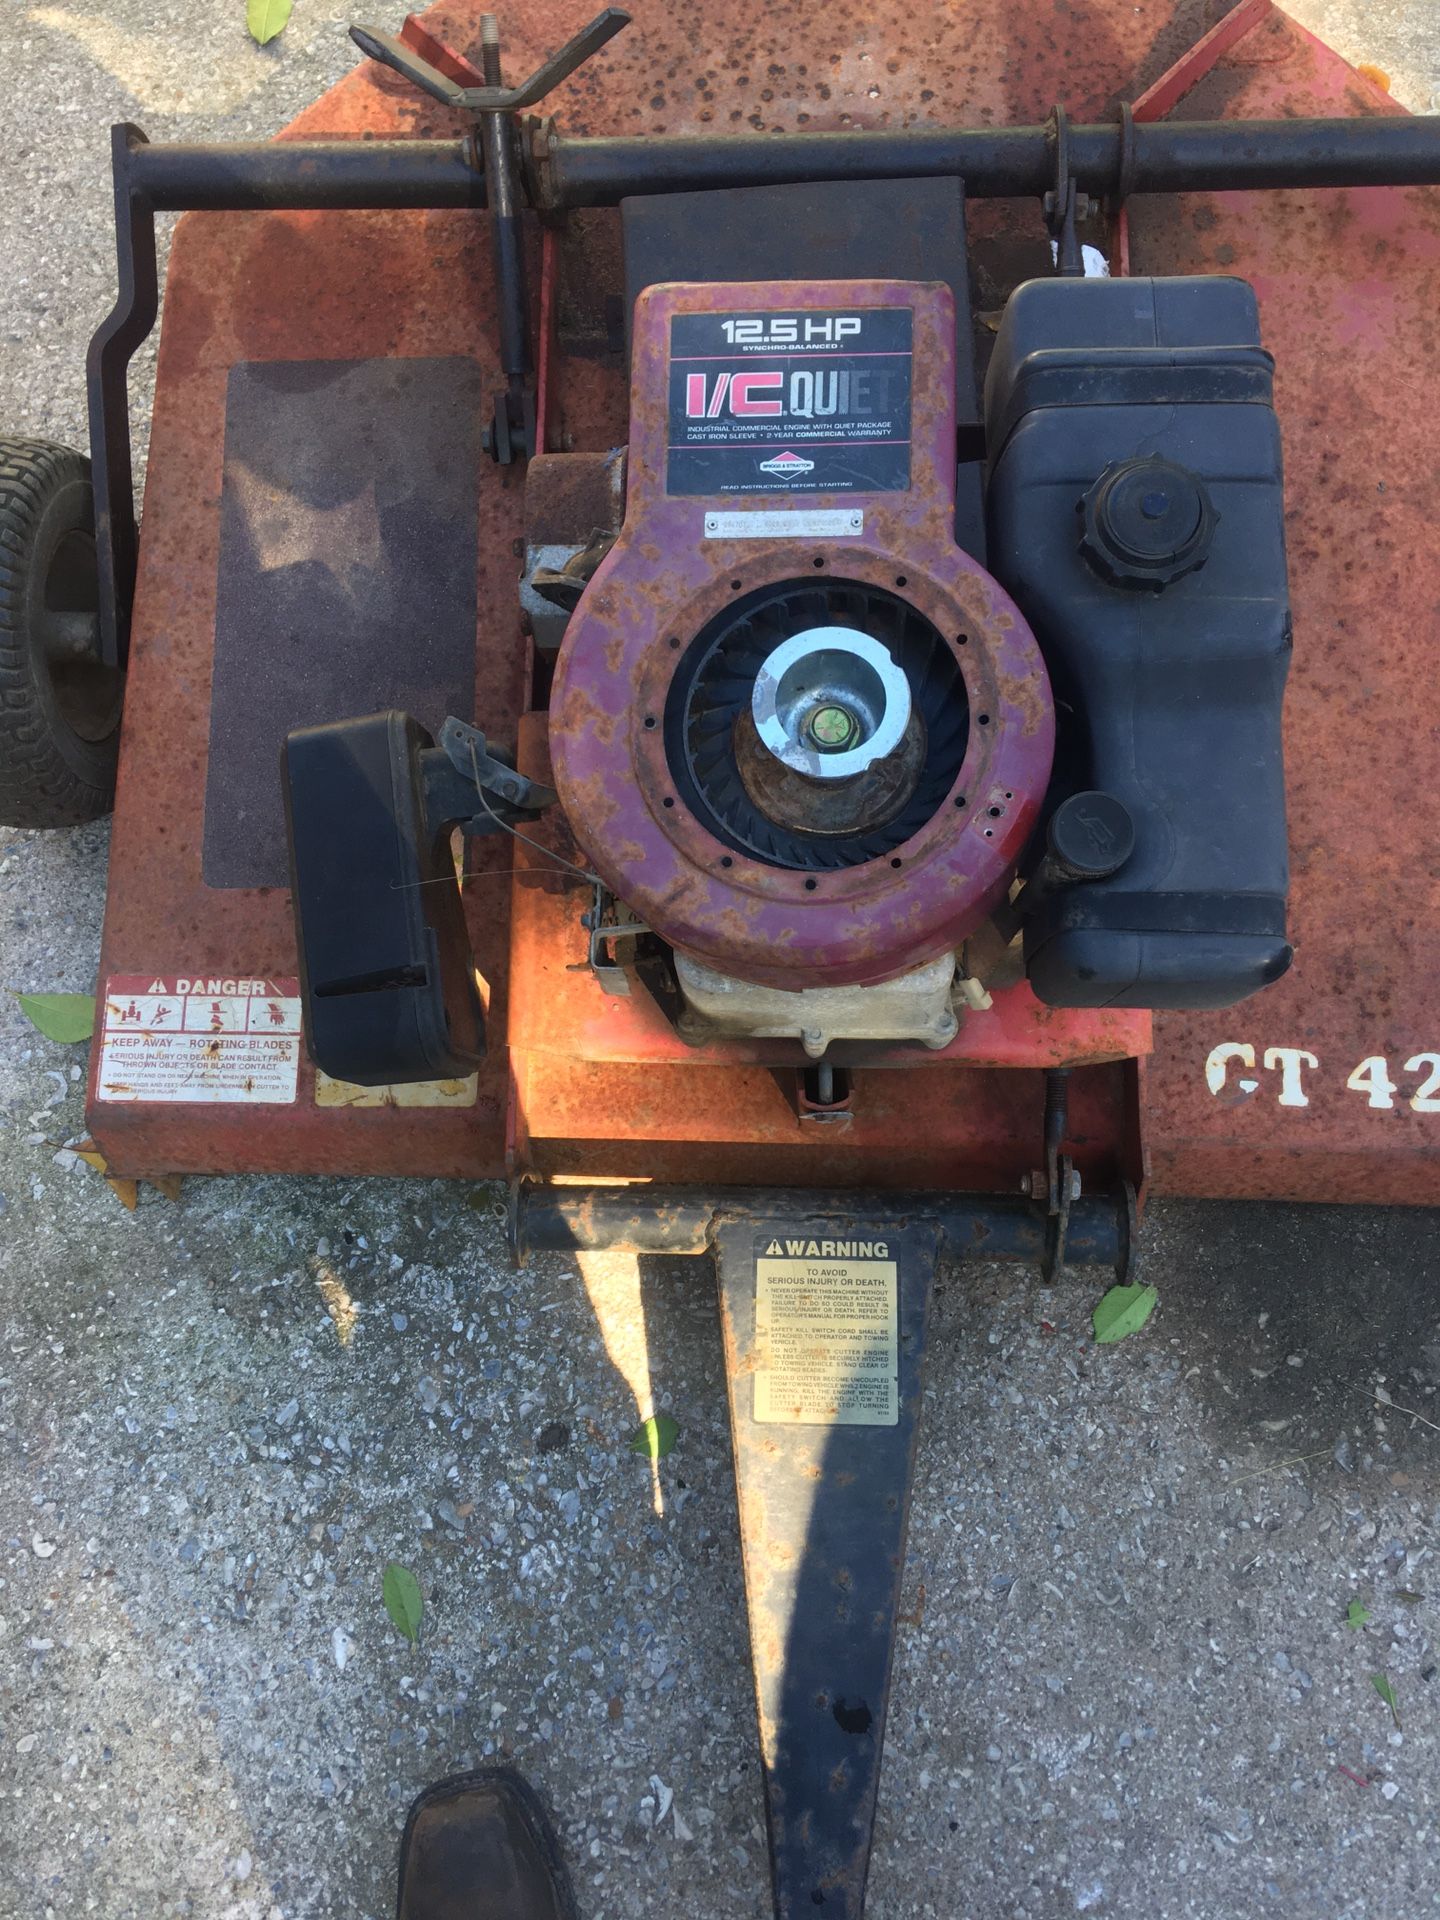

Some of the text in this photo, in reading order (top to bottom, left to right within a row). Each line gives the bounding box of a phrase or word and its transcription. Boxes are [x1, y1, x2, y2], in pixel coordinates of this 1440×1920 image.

[721, 318, 861, 343] 12.5 HP
[789, 370, 895, 418] QUIET
[732, 424, 781, 432] COMMERCIAL
[833, 422, 856, 430] QUIET
[857, 421, 892, 429] PACKAGE
[729, 432, 757, 440] SLEEVE
[795, 430, 846, 438] COMMERCIAL
[847, 429, 892, 437] WARRANTY
[175, 979, 266, 995] DANGER
[112, 1038, 141, 1048] KEEP
[142, 1038, 174, 1048] AWAY
[249, 1040, 292, 1050] BLADES
[146, 1053, 175, 1061] INJURY
[189, 1054, 217, 1062] DEATH
[218, 1054, 236, 1062] CAN
[122, 1061, 157, 1069] THROWN
[196, 1062, 209, 1070] OR
[1346, 1052, 1440, 1113] 42
[785, 1240, 889, 1258] WARNING
[806, 1268, 848, 1277] TO AVOID
[767, 1277, 805, 1285] SERIOUS
[807, 1278, 838, 1286] INJURY
[840, 1278, 853, 1286] OR
